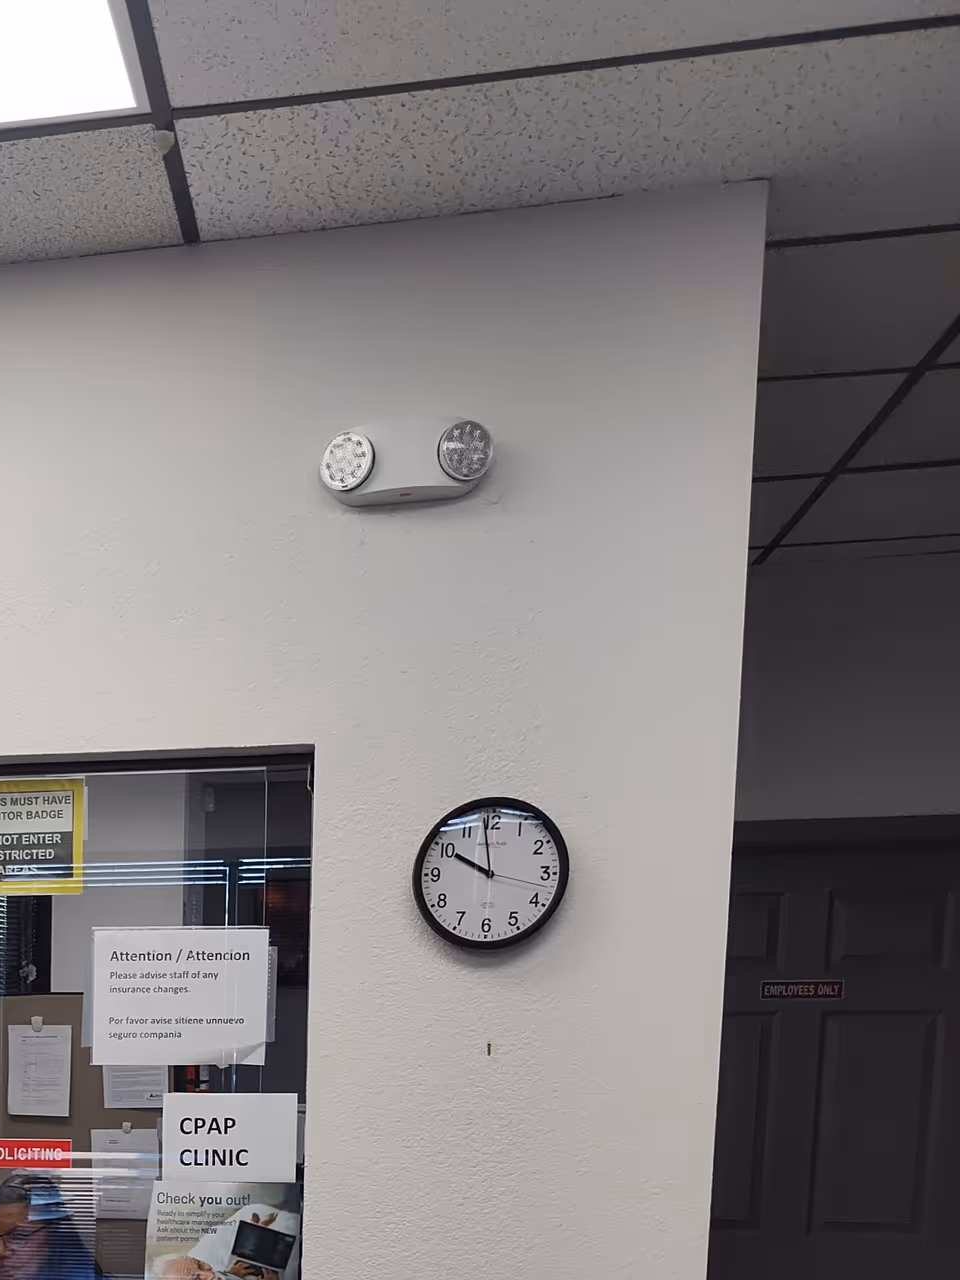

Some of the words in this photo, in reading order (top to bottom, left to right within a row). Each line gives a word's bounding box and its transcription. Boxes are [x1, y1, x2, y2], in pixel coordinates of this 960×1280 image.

[10, 796, 39, 806] MUST
[42, 795, 71, 805] HAVE
[26, 809, 64, 819] BADGE
[485, 815, 501, 830] 12
[22, 833, 61, 844] ENTER
[462, 825, 471, 838] 11
[440, 843, 455, 858] 10
[533, 840, 543, 855] 2
[430, 867, 440, 882] 9
[540, 866, 550, 881] 3
[437, 893, 447, 908] 8
[529, 893, 540, 907] 4
[456, 911, 466, 926] 7
[481, 918, 491, 933] 6
[508, 911, 518, 926] 5
[110, 950, 172, 962] Attention
[175, 949, 183, 963] /
[186, 949, 250, 961] Attencion
[109, 971, 137, 980] Please
[139, 971, 167, 980] advise
[169, 971, 190, 979] staff
[191, 971, 201, 979] of
[202, 972, 219, 981] any
[109, 985, 151, 994] insurance
[153, 985, 191, 995] changes.
[764, 984, 815, 996] EMPLOYEES
[818, 984, 840, 995] ONLY
[109, 1016, 123, 1025] Por
[125, 1016, 148, 1025] favor
[150, 1017, 173, 1025] avise
[174, 1016, 204, 1025] sitiene
[206, 1017, 245, 1025] unnuevo
[108, 1031, 137, 1040] seguro
[139, 1030, 182, 1040] compania
[179, 1117, 236, 1135] CPAP
[179, 1149, 249, 1167] CLINIC
[157, 1191, 195, 1204] Check
[199, 1196, 222, 1207] you
[225, 1194, 251, 1206] out!
[185, 1210, 210, 1218] simplify
